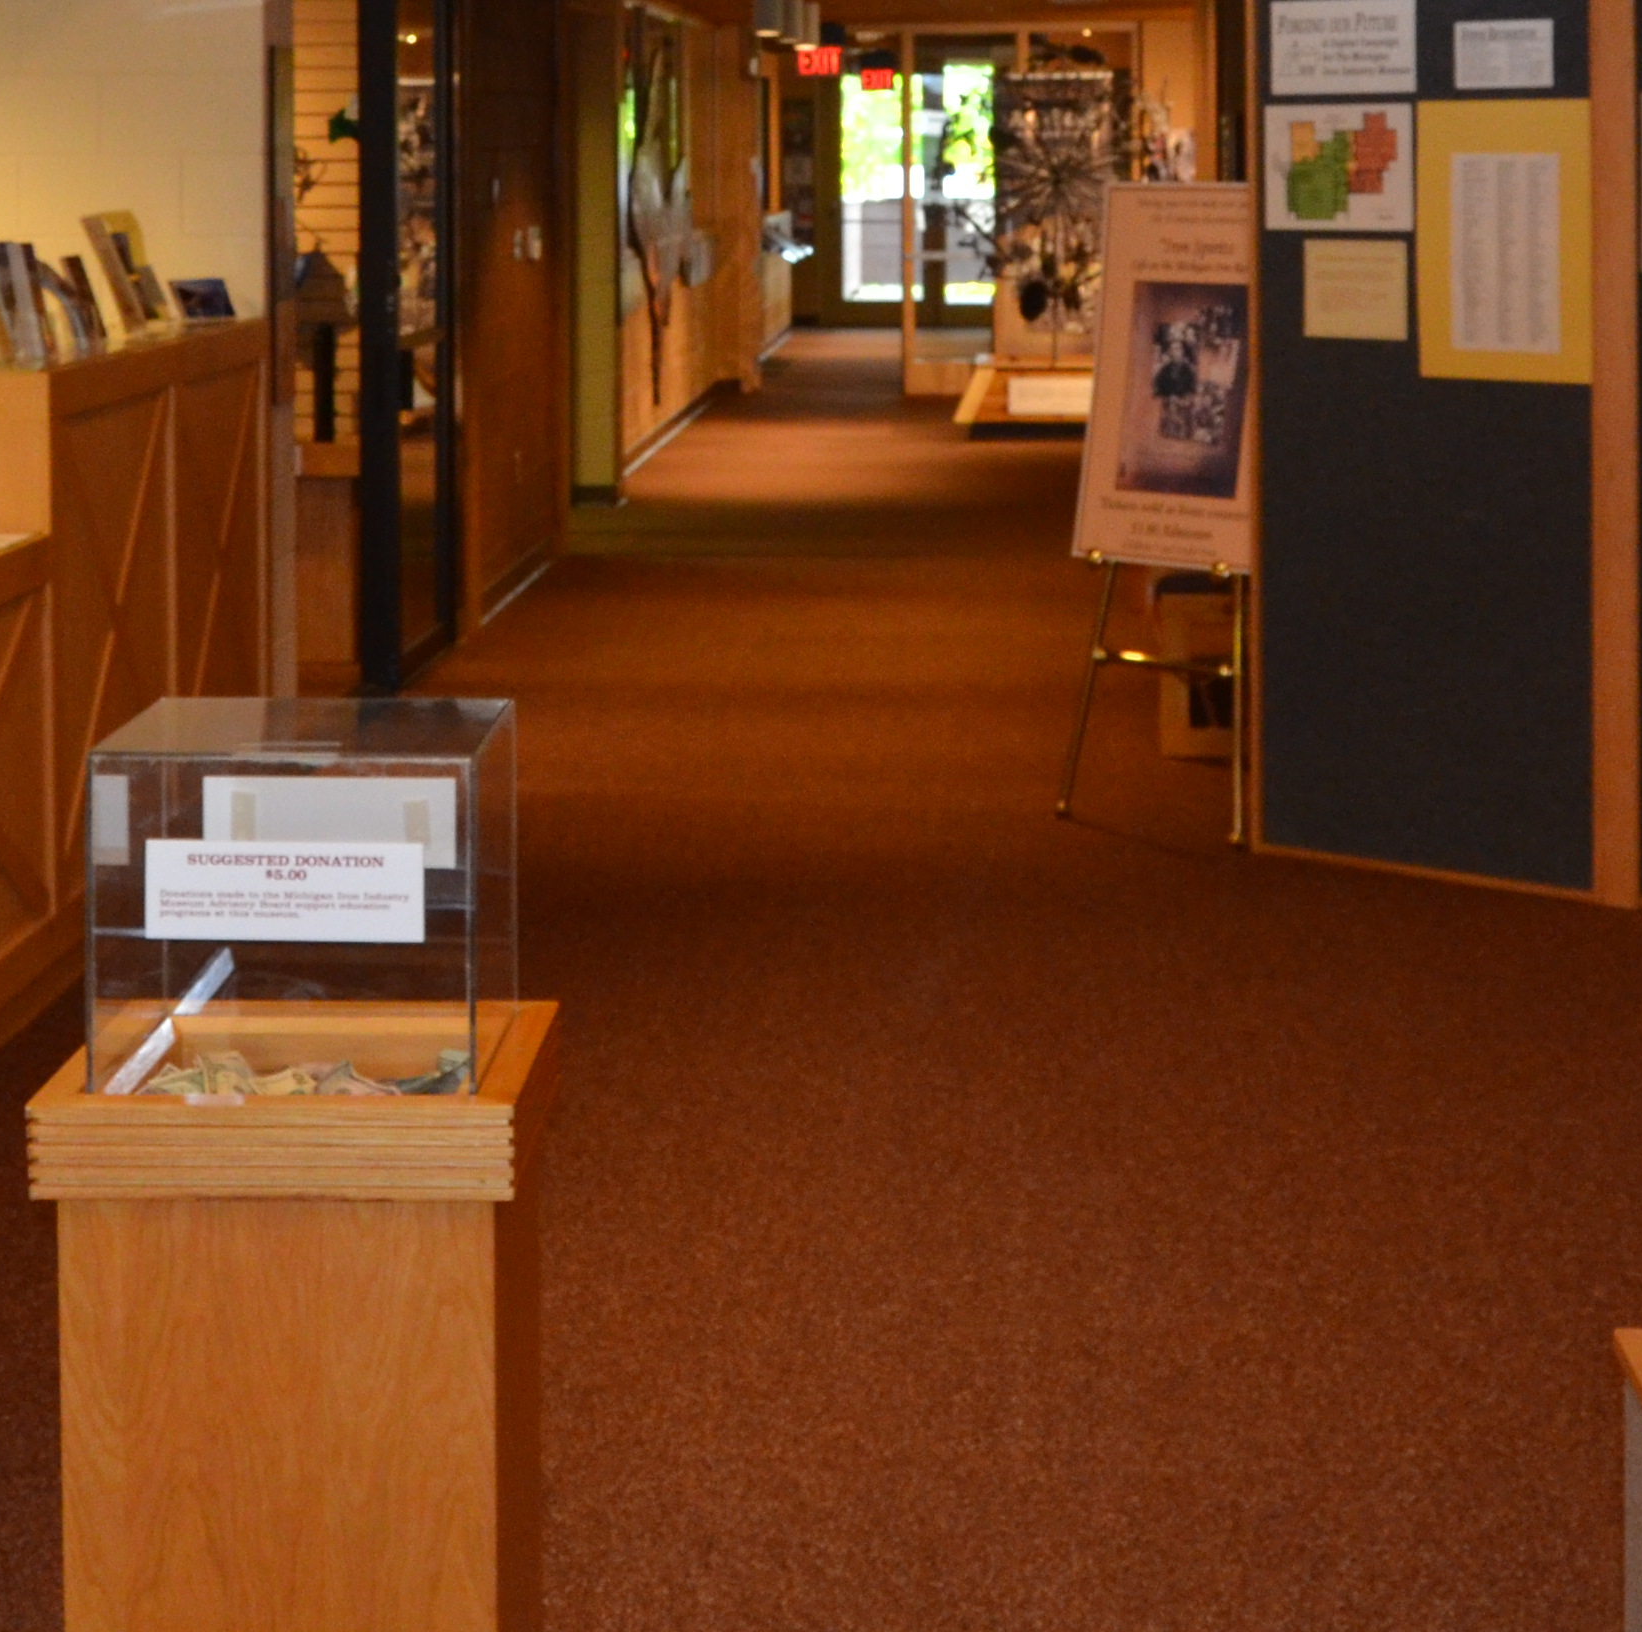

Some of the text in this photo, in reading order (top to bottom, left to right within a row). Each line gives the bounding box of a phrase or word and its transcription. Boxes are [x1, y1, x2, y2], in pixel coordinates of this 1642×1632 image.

[798, 45, 843, 76] EXIT
[861, 68, 894, 90] EXIT
[186, 853, 385, 868] SUGGESTED DONATION
[265, 869, 307, 881] $5.00
[215, 890, 245, 899] made
[248, 891, 260, 899] to
[263, 890, 280, 899] the
[283, 890, 333, 902] Michigan
[337, 891, 360, 900] Iron
[363, 892, 410, 903] Industry
[294, 901, 335, 912] support
[214, 909, 225, 917] at
[229, 909, 250, 918] this
